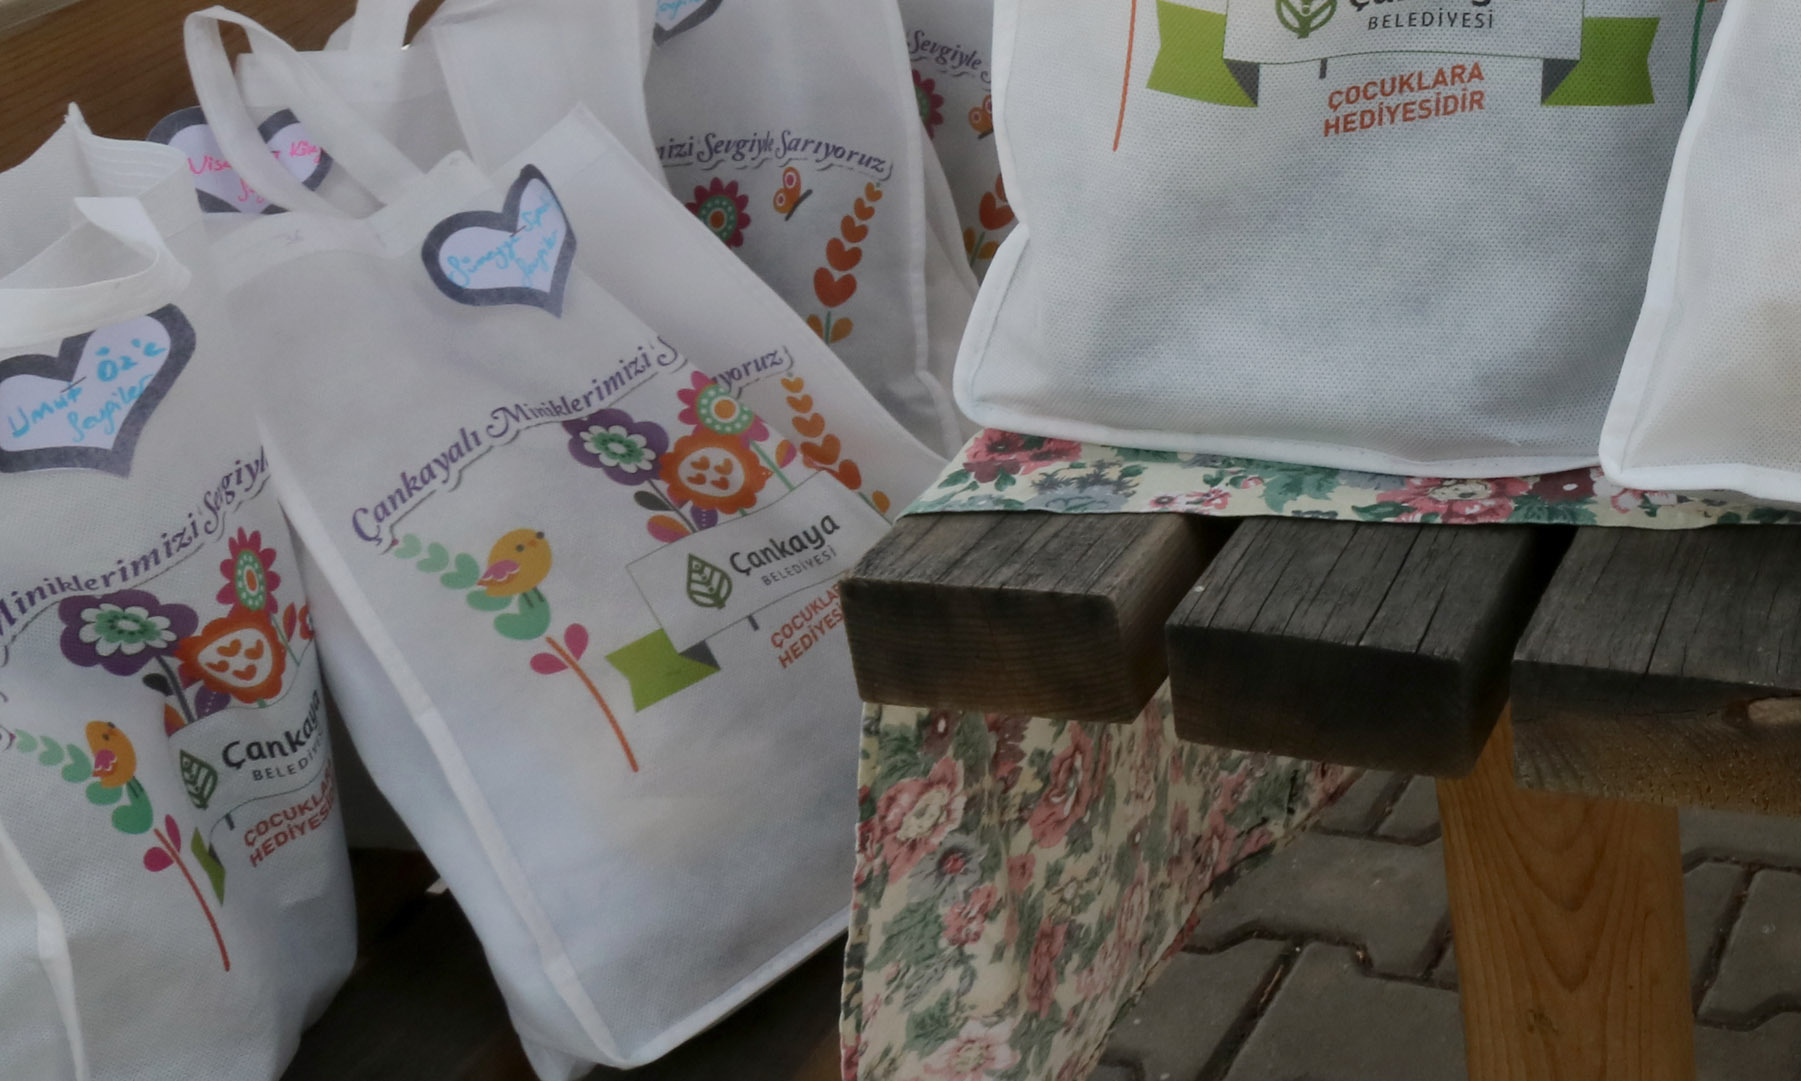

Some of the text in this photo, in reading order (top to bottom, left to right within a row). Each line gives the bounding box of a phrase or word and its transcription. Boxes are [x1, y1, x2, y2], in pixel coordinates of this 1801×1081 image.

[1367, 7, 1493, 30] BELEDİYESİ
[1322, 88, 1486, 138] HEDİYESİDİR
[1327, 61, 1485, 111] ÇOCUKLARA
[775, 129, 887, 173] Sarıyoruz
[352, 345, 784, 546] Çankayalı Miniklerimizi yoruz
[729, 514, 841, 576] Çankaya
[761, 544, 837, 587] BELEDİYESİ
[770, 582, 842, 649] ÇOCUKLAR
[777, 601, 844, 669] HEDİYES
[222, 689, 320, 770] Çankaya
